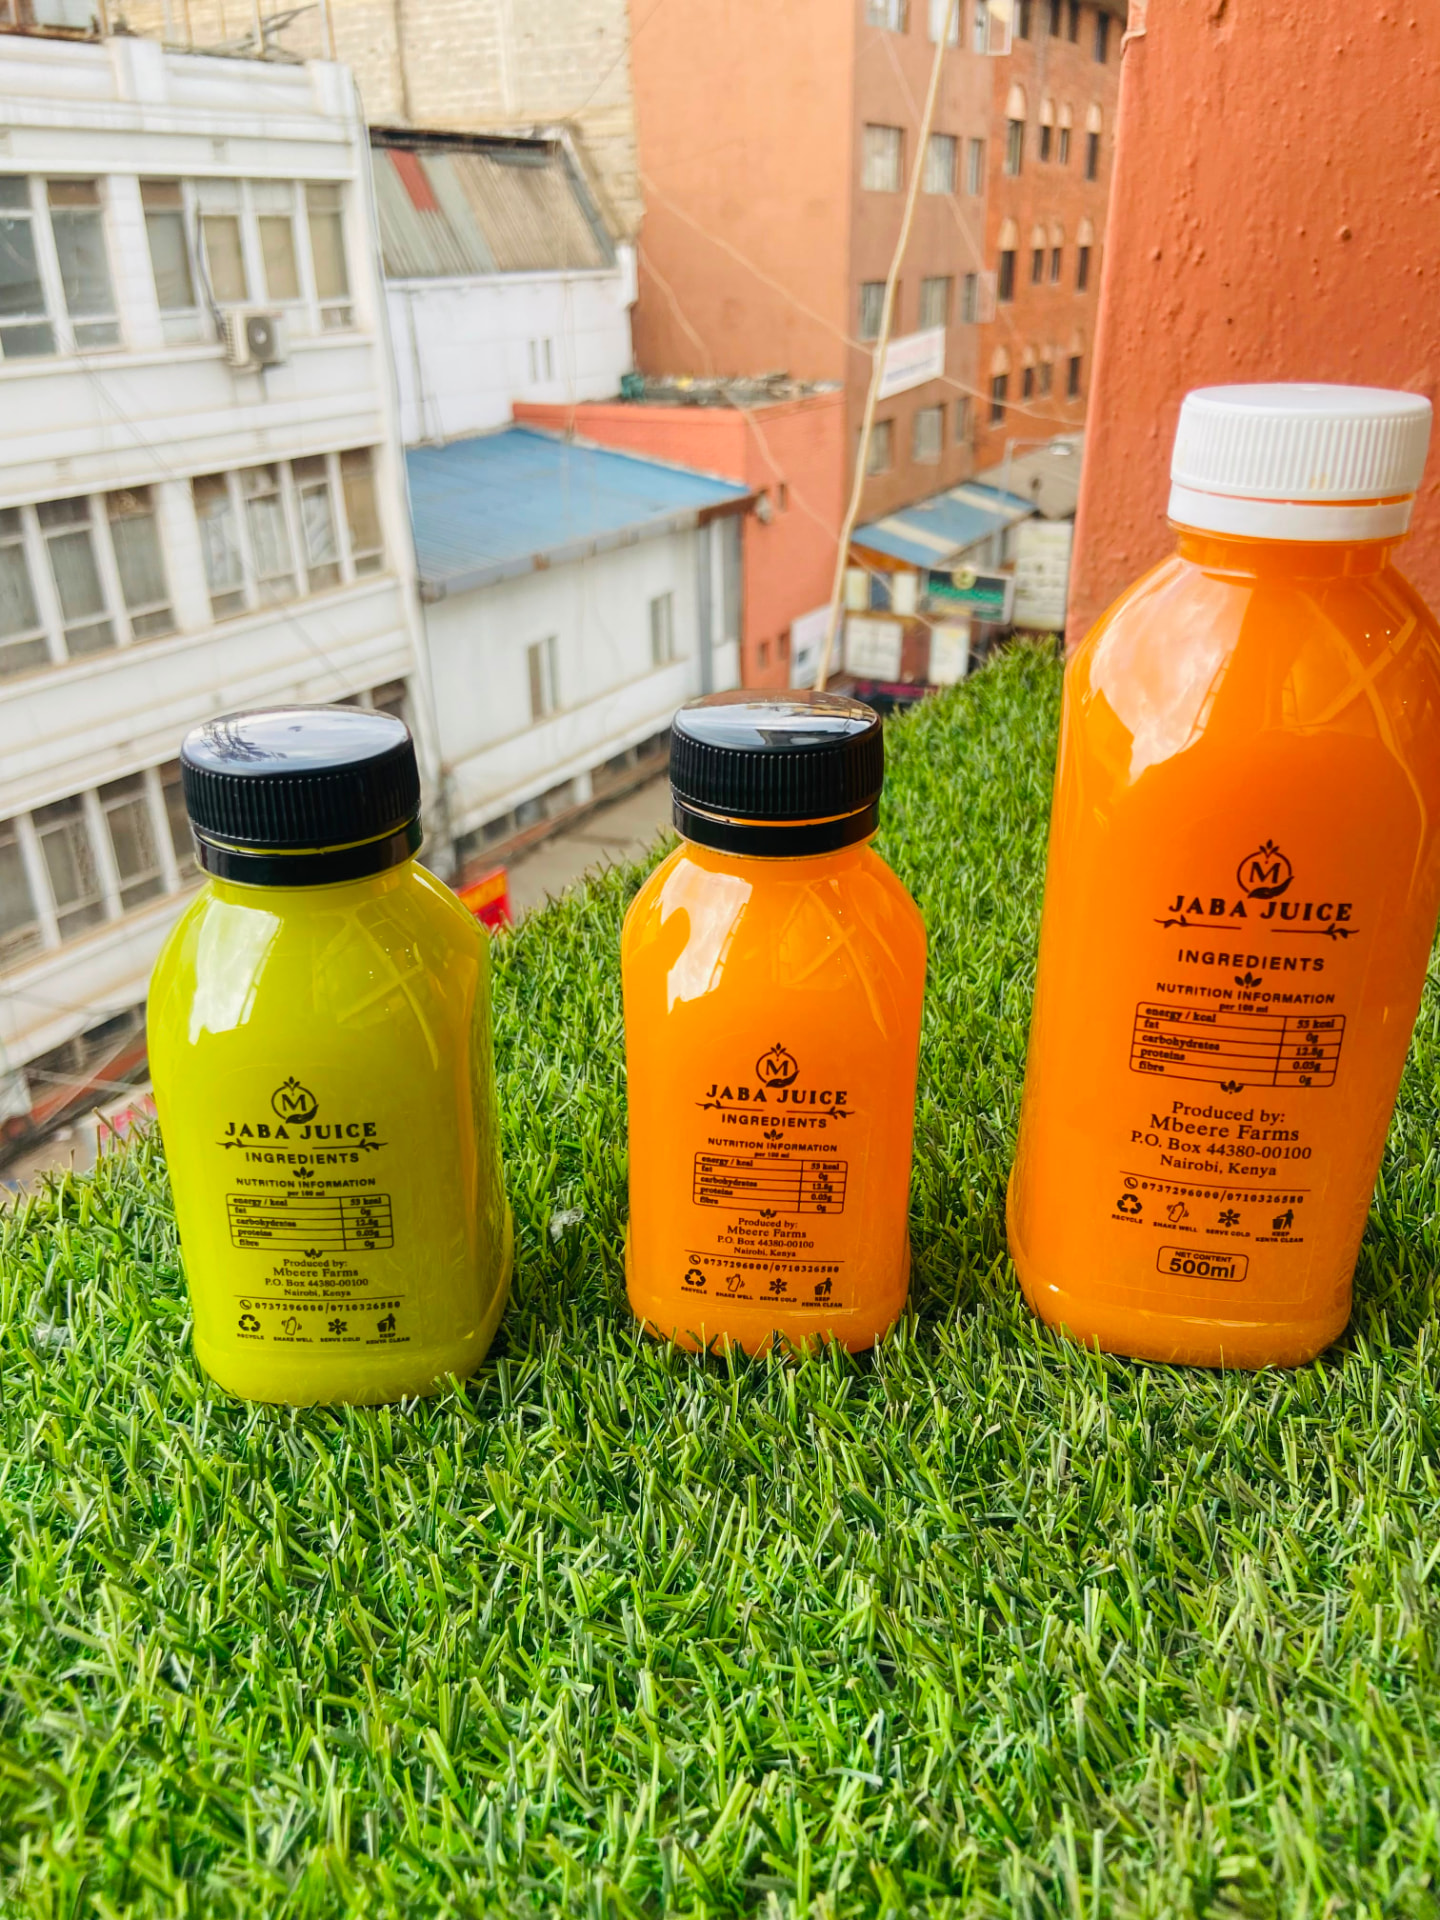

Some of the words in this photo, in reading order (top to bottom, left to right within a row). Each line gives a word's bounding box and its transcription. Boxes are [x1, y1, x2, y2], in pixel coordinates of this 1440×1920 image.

[1249, 862, 1281, 883] M
[1168, 895, 1247, 918] JABA
[1260, 901, 1352, 922] JUICE
[1178, 949, 1325, 972] INGREDIENTS
[1156, 982, 1233, 999] NUTRITION
[1238, 991, 1335, 1004] INFORMATION
[1219, 1003, 1234, 1012] per
[1238, 1004, 1253, 1012] 100
[1256, 1005, 1268, 1013] ml
[1146, 1007, 1182, 1021] energy
[1193, 1012, 1216, 1023] kcal
[1313, 1019, 1335, 1028] kcal
[1144, 1020, 1159, 1029] fat
[1306, 1032, 1318, 1043] 0g
[1142, 1033, 1219, 1051] carbohydrates
[1140, 1048, 1185, 1061] proteins
[766, 1059, 789, 1076] M
[1139, 1061, 1164, 1072] fibre
[1299, 1075, 1312, 1086] 0g
[706, 1084, 767, 1102] JABA
[777, 1090, 847, 1105] JUICE
[282, 1094, 307, 1111] M
[1172, 1101, 1254, 1121] Produced
[1260, 1109, 1285, 1126] by:
[722, 1114, 827, 1128] INGREDIENTS
[225, 1123, 289, 1139] JABA
[300, 1123, 377, 1139] JUICE
[1150, 1114, 1229, 1138] Mbeere
[1237, 1124, 1299, 1141] Farms
[708, 1138, 763, 1149] NUTRITION
[767, 1142, 837, 1152] INFORMATION
[1131, 1130, 1162, 1148] P.O.
[1168, 1138, 1201, 1154] Box
[1207, 1143, 1311, 1159] 44380-00100
[246, 1152, 359, 1164] INGREDIENTS
[702, 1156, 729, 1166] energy
[1160, 1154, 1223, 1174] Nairobi,
[1228, 1163, 1276, 1178] Kenya
[701, 1176, 757, 1187] carbohydrates
[818, 1172, 828, 1180] 0g
[236, 1177, 294, 1188] NUTRITION
[298, 1178, 376, 1188] INFORMATION
[700, 1187, 733, 1195] proteins
[233, 1198, 262, 1206] energy
[360, 1208, 371, 1216] 0g
[817, 1204, 826, 1212] 0g
[236, 1218, 296, 1228] carbohydrates
[738, 1218, 781, 1227] Produced
[784, 1220, 797, 1229] by:
[1112, 1214, 1143, 1224] RECYCLE
[1153, 1221, 1176, 1229] SHAKE
[238, 1229, 272, 1238] proteins
[727, 1226, 769, 1237] Mbeere
[774, 1228, 806, 1238] Farms
[239, 1239, 259, 1247] fibre
[364, 1240, 374, 1248] 0g
[737, 1237, 755, 1246] Box
[758, 1239, 814, 1248] 44380-00100
[734, 1247, 767, 1256] Nairobi,
[1175, 1251, 1191, 1259] NET
[1193, 1253, 1232, 1262] CONTENT
[283, 1259, 329, 1267] Produced
[332, 1260, 347, 1269] by:
[1169, 1258, 1235, 1278] 500ml
[273, 1268, 318, 1277] Mbeere
[322, 1269, 358, 1277] Farms
[265, 1278, 283, 1286] P.O.
[286, 1279, 305, 1287] Box
[308, 1279, 368, 1287] 44380-00100
[284, 1289, 320, 1297] Nairobi,
[681, 1286, 707, 1294] RECYCLE
